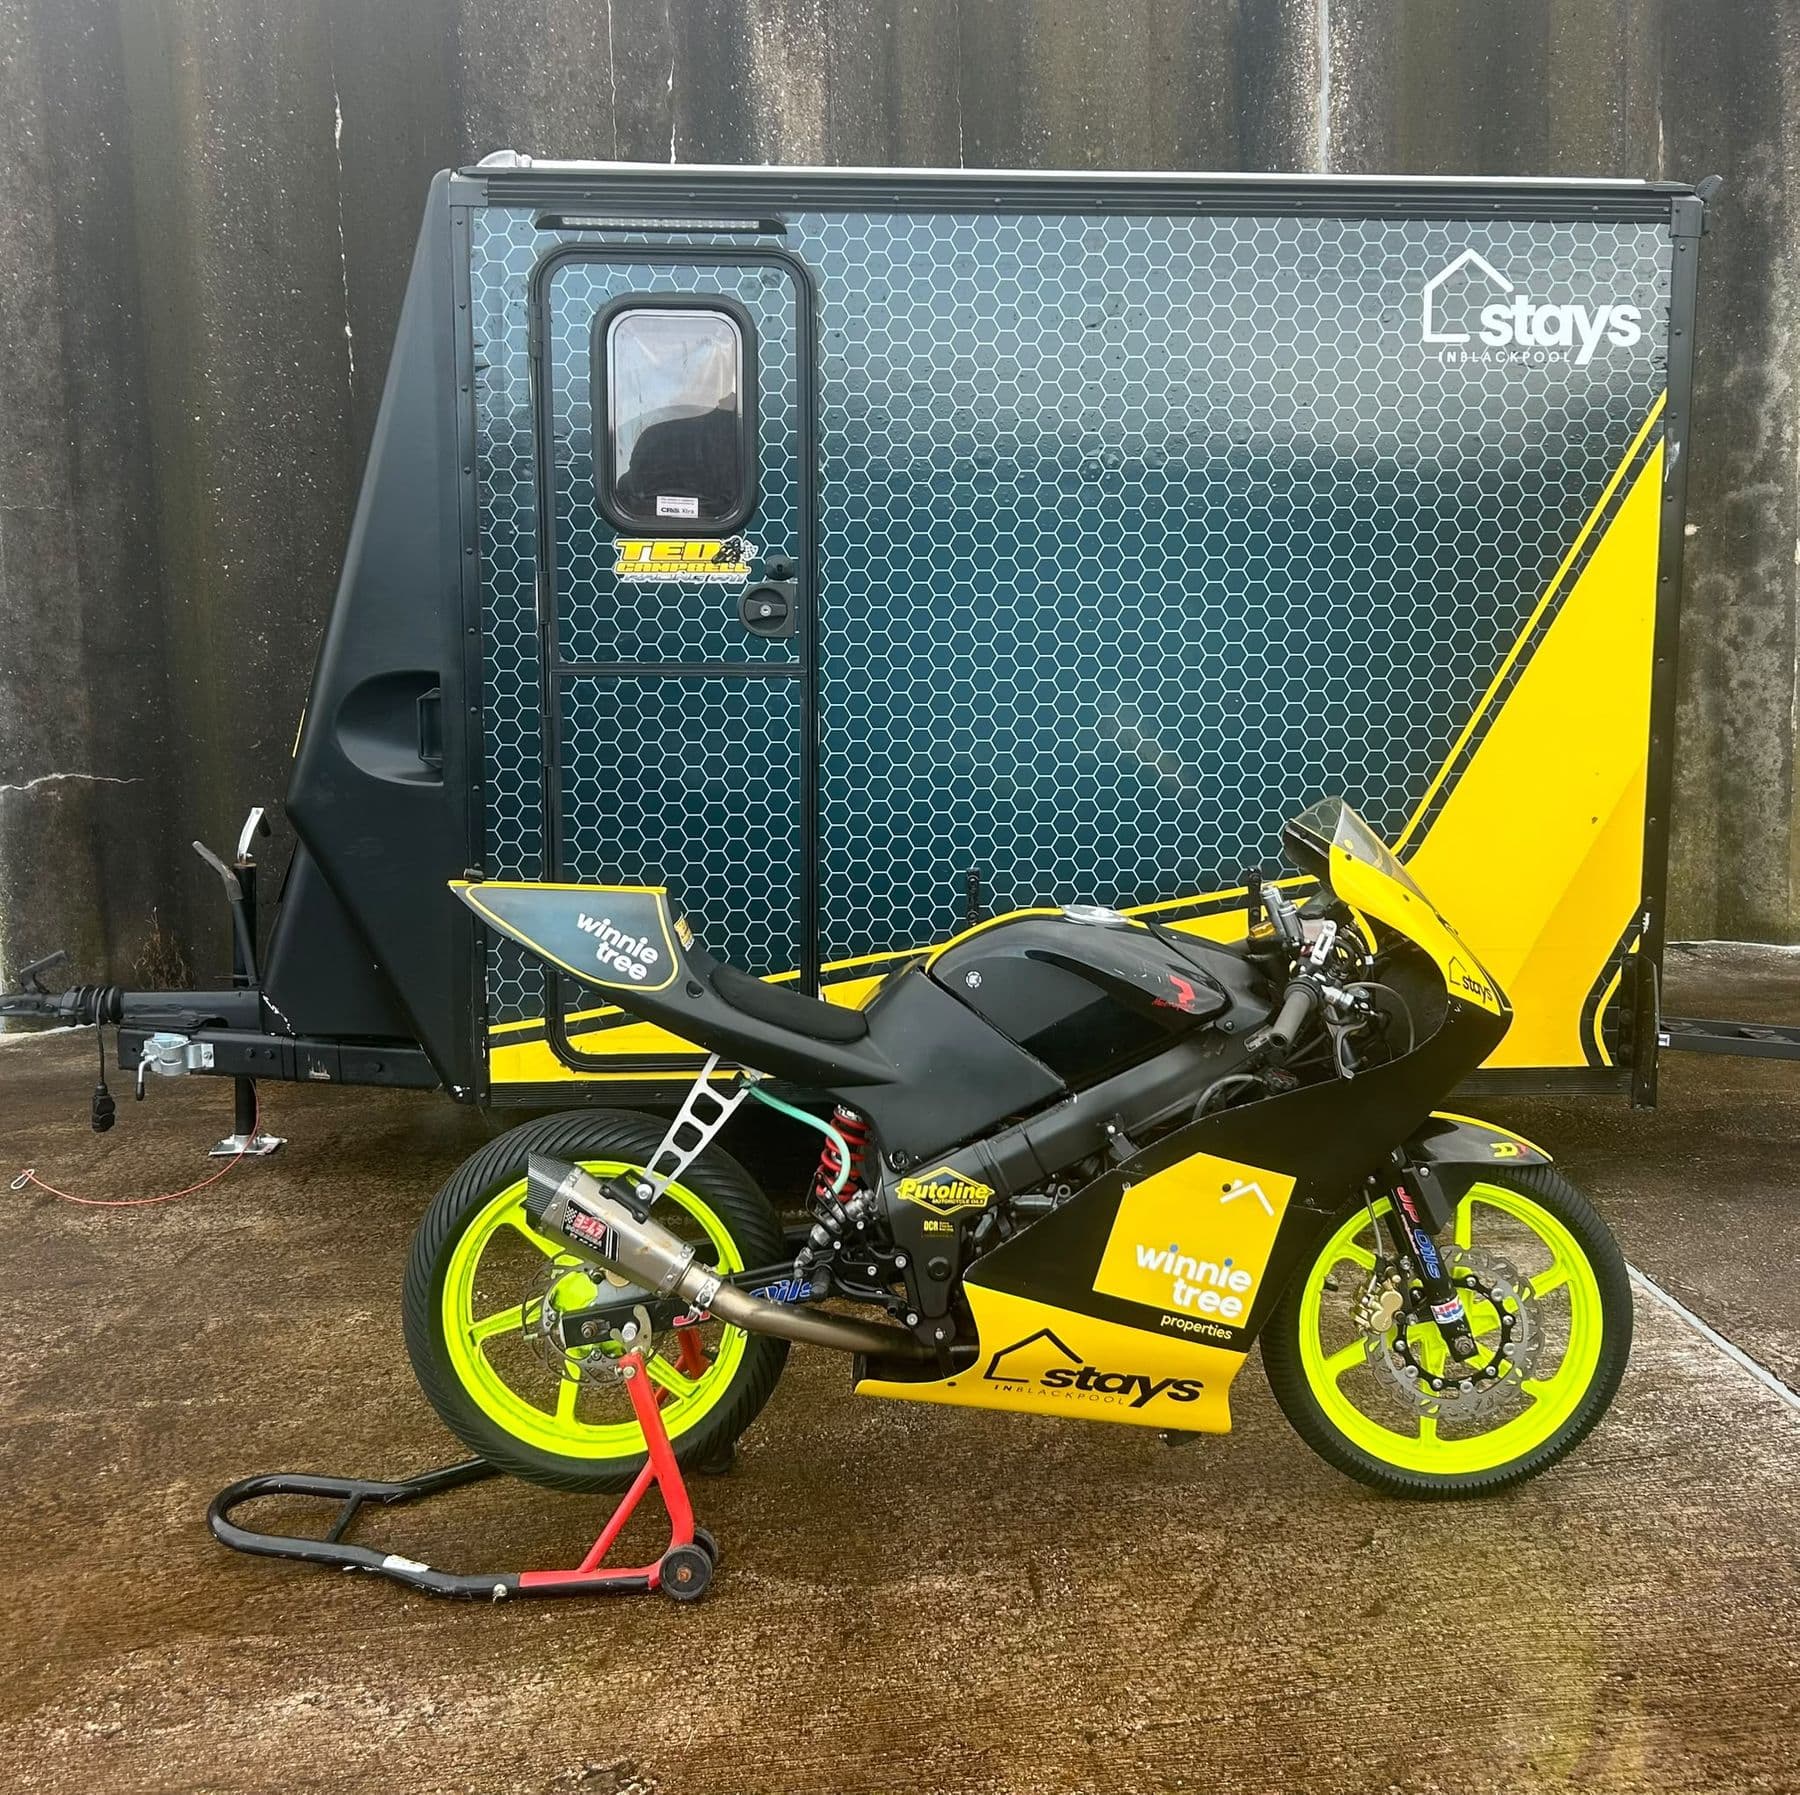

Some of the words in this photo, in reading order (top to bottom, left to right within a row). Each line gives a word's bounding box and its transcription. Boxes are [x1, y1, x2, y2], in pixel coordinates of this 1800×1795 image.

[1479, 295, 1642, 365] stays
[1438, 351, 1572, 363] INBLACKPOOL
[616, 540, 723, 562] TED
[616, 561, 750, 573] CAMPBELL
[576, 912, 659, 965] winnie
[595, 941, 648, 981] tree
[1462, 975, 1493, 1004] stays
[899, 1180, 990, 1200] Putoline
[1396, 1185, 1422, 1223] JP
[1135, 1243, 1253, 1293] winnie
[1172, 1278, 1243, 1318] tree
[1160, 1314, 1233, 1339] properties
[993, 1384, 1125, 1405] INBLACKPOOL
[1039, 1366, 1204, 1408] stays
